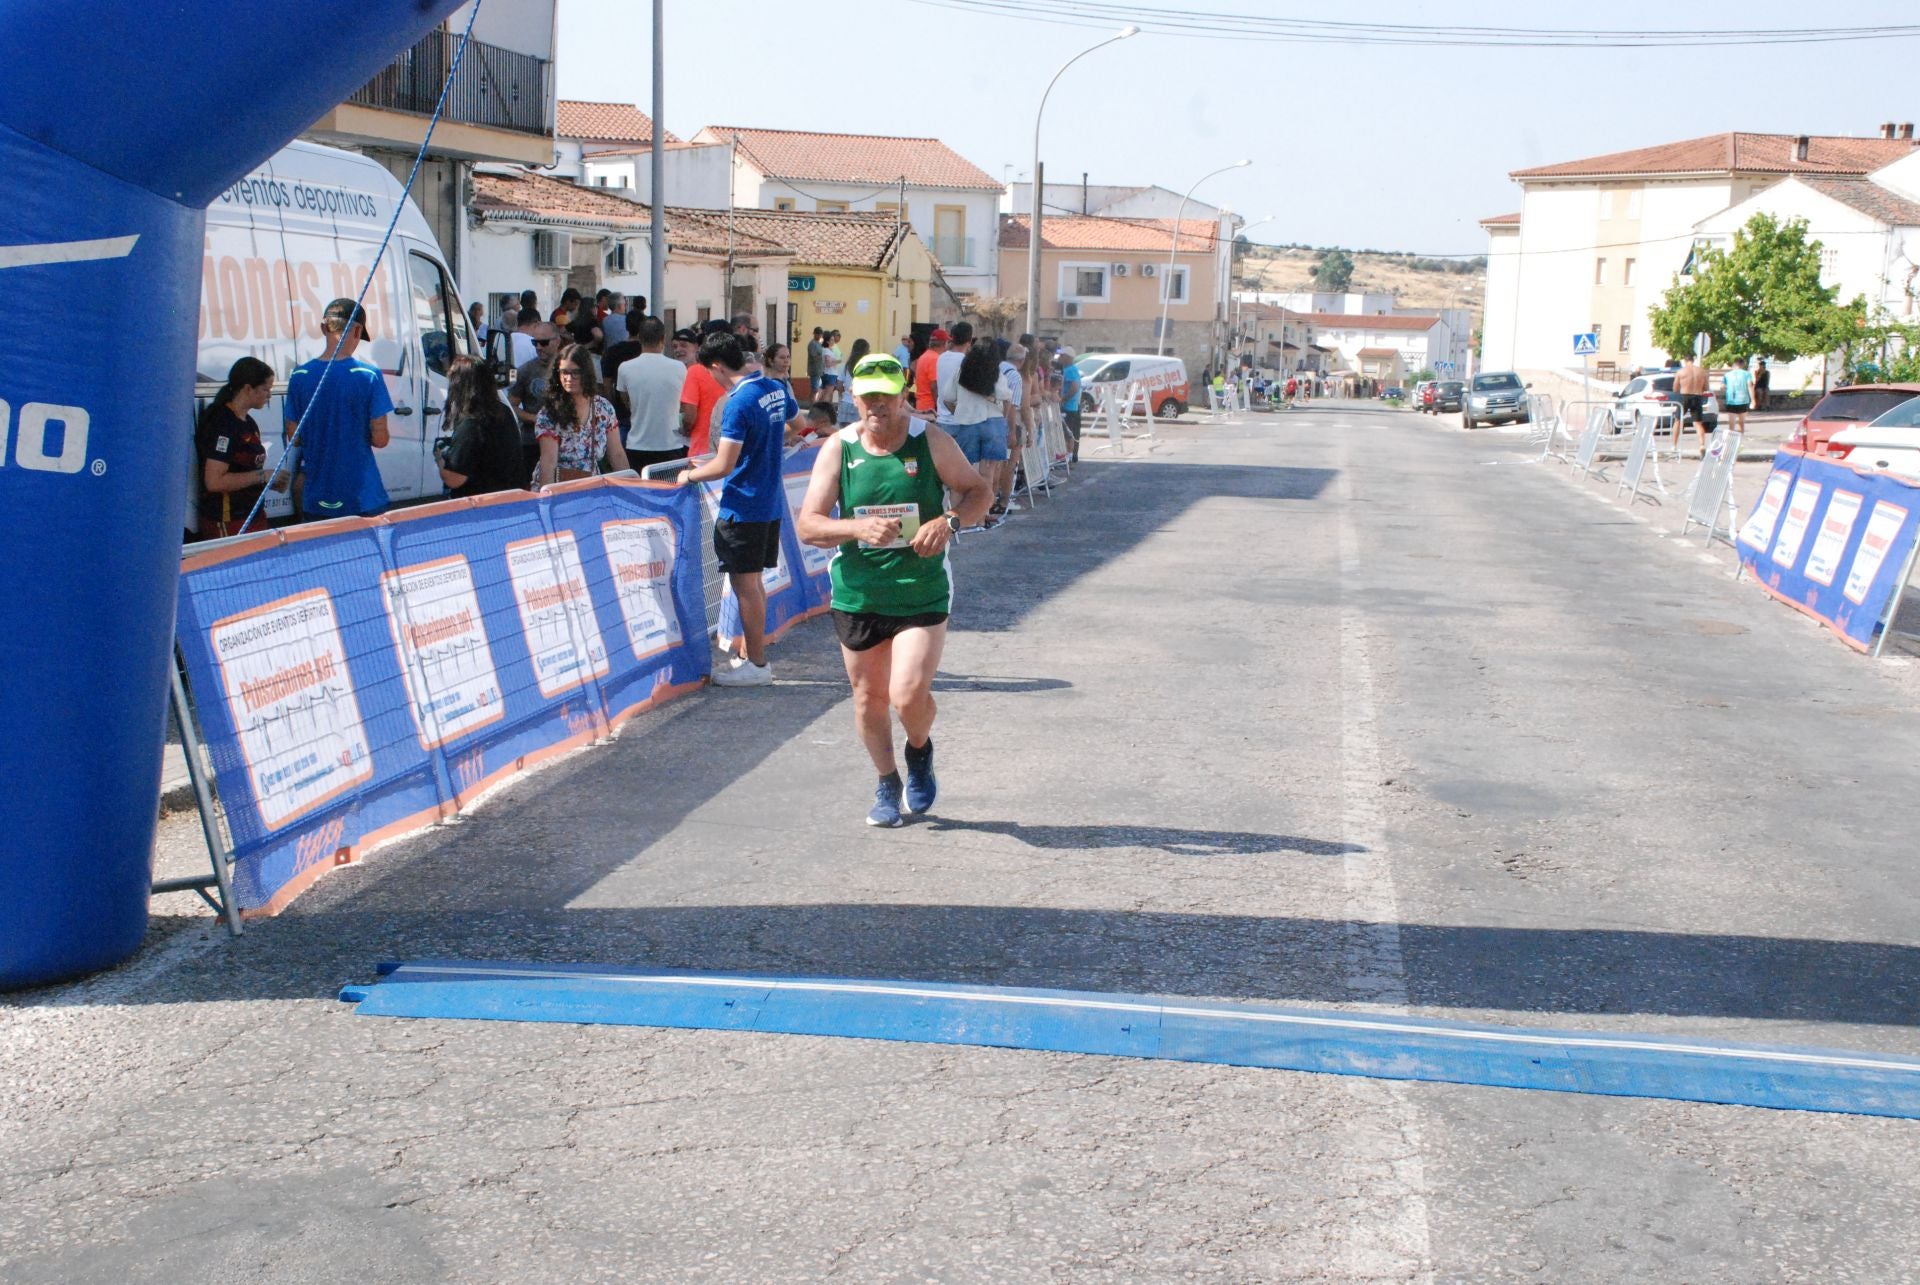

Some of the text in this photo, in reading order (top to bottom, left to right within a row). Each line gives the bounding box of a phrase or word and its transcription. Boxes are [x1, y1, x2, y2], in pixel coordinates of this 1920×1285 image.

[294, 178, 378, 218] deportivos
[261, 621, 272, 637] DE
[239, 648, 338, 714] Pulsaciones.net
